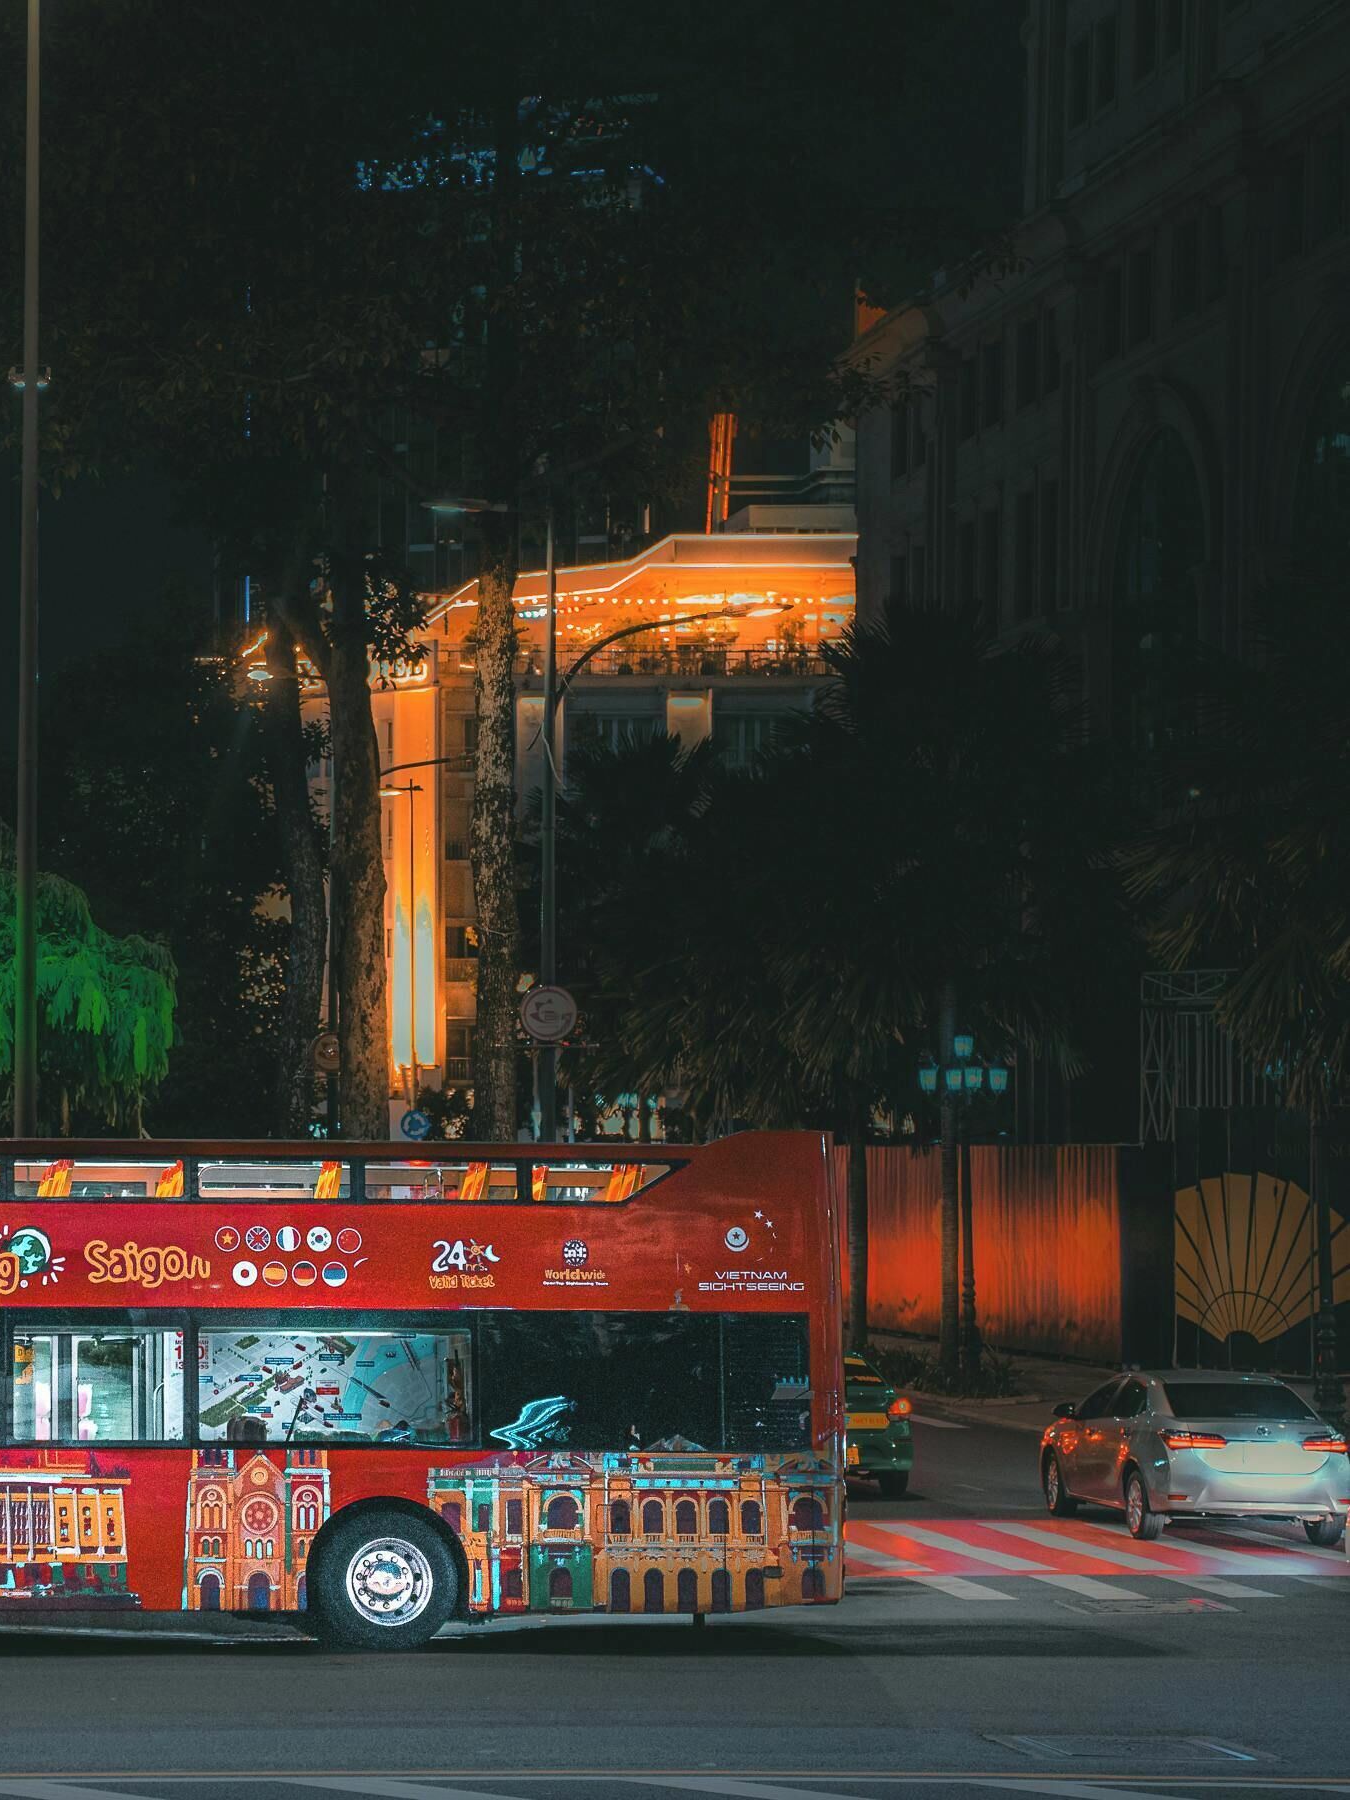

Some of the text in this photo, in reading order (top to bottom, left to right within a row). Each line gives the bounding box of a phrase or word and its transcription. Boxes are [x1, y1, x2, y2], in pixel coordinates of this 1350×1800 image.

[432, 1239, 467, 1272] 24
[84, 1239, 211, 1288] Saigon
[544, 1268, 607, 1280] Worldwide
[714, 1271, 788, 1280] VIETNAM
[428, 1274, 496, 1289] Valid Ticket
[697, 1282, 805, 1291] SIGHTSEEING
